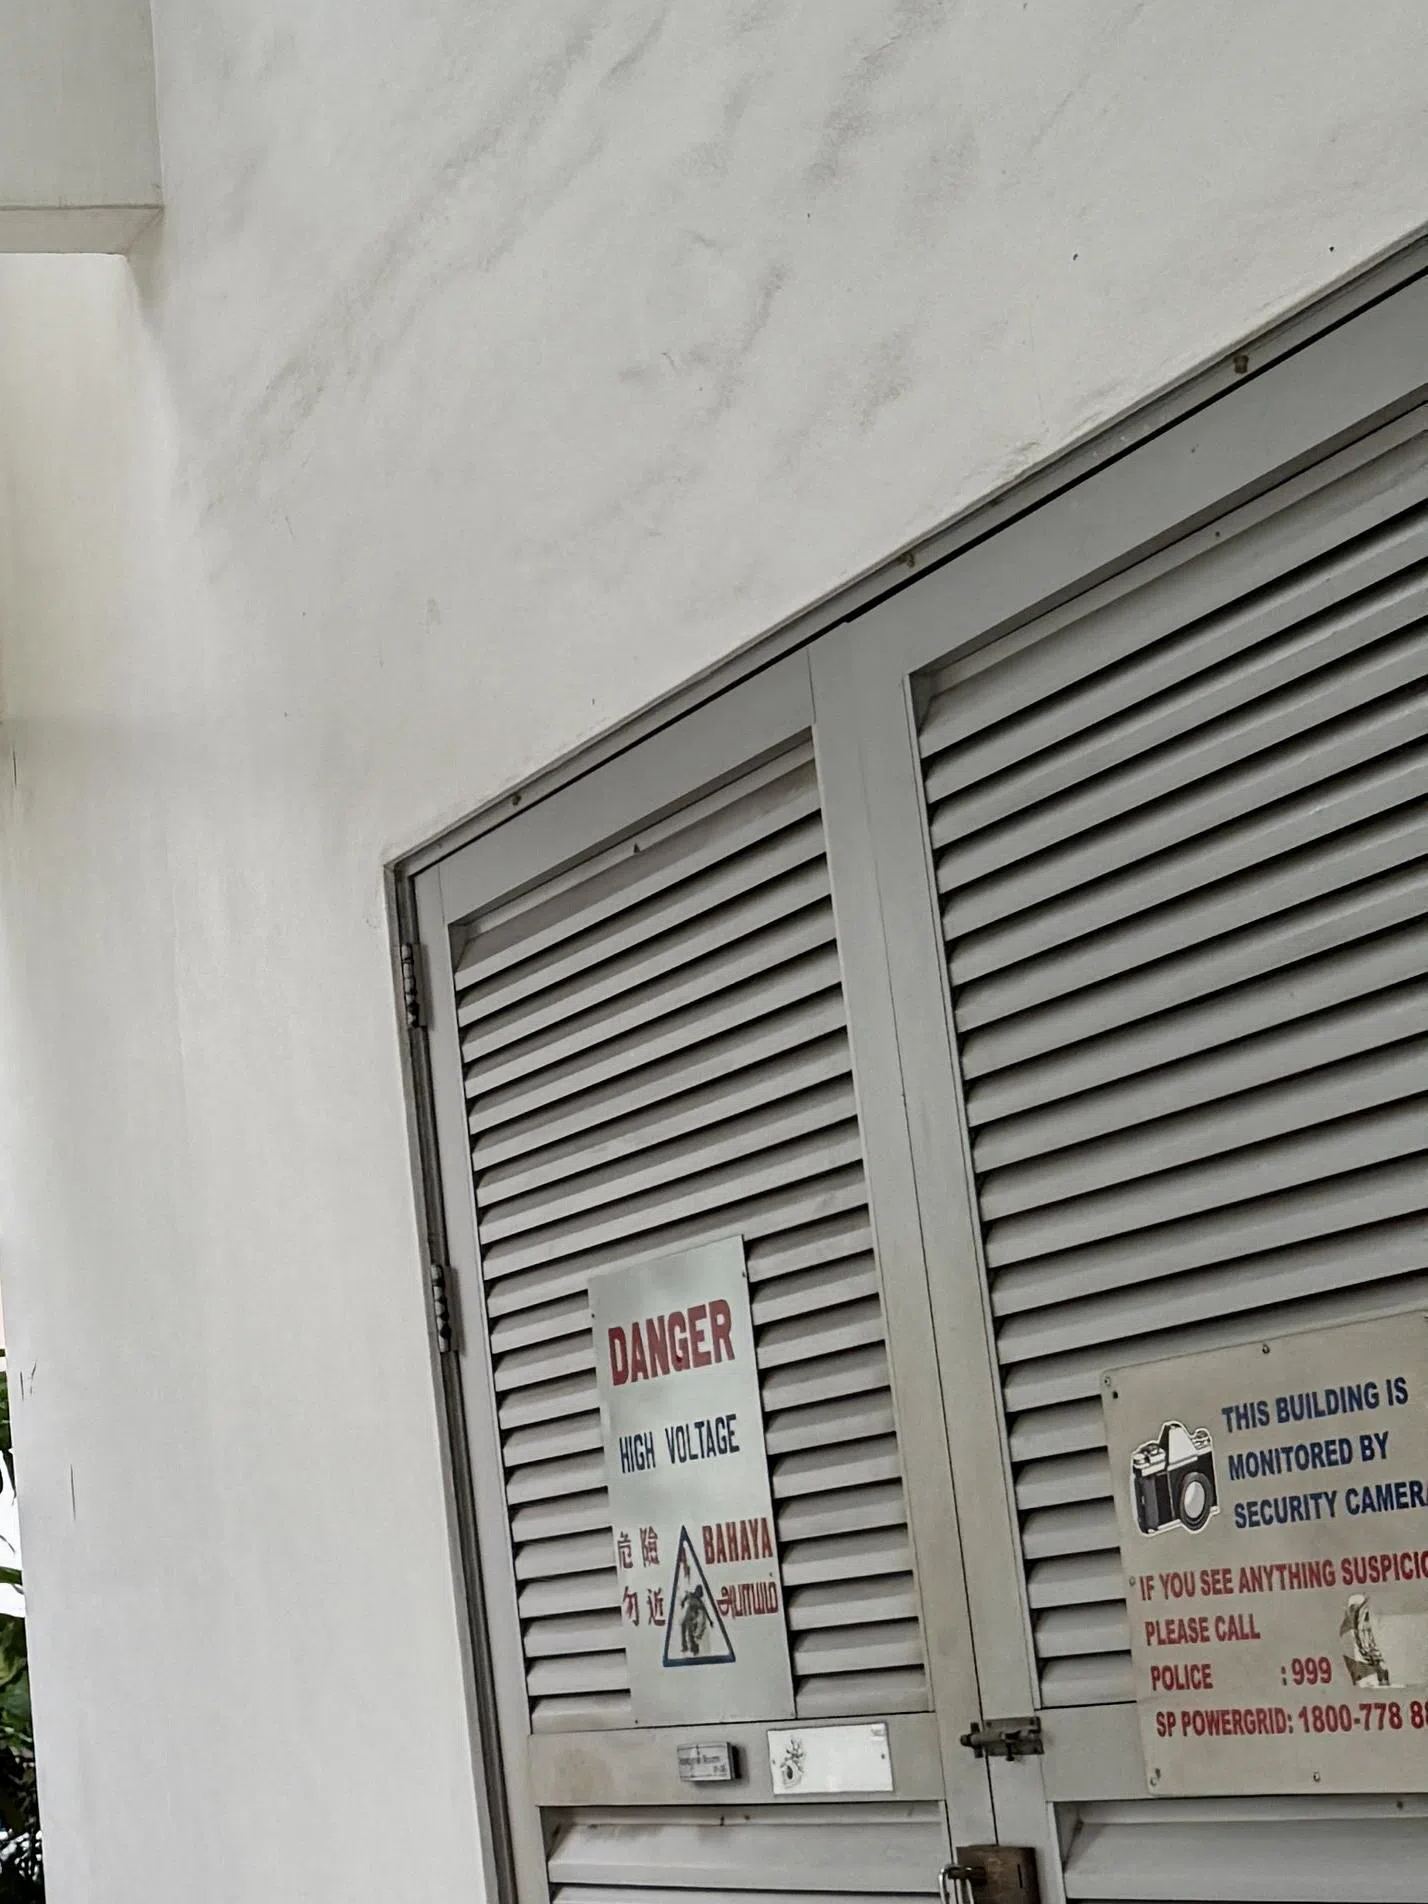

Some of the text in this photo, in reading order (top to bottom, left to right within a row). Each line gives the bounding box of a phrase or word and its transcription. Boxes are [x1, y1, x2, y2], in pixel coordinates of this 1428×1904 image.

[608, 1299, 735, 1386] DANGER
[1221, 1377, 1409, 1433] THIS BUILDING IS
[619, 1413, 740, 1474] HIGH VOLTAGE
[1228, 1431, 1389, 1481] MONITORED BY
[1234, 1480, 1428, 1529] SECURITY CAMER
[617, 1526, 660, 1570] 危險
[702, 1517, 774, 1565] BAHAYA
[1140, 1575, 1154, 1601] IF
[1159, 1571, 1196, 1600] YOU
[1200, 1567, 1233, 1596] SEE
[1239, 1559, 1336, 1594] ANYTHING
[622, 1585, 666, 1627] 勿近
[1145, 1613, 1261, 1646] PLEASE CALL
[1150, 1663, 1213, 1691] POLICE
[1156, 1700, 1428, 1738] SP POWERGRID: 1800-778 8
